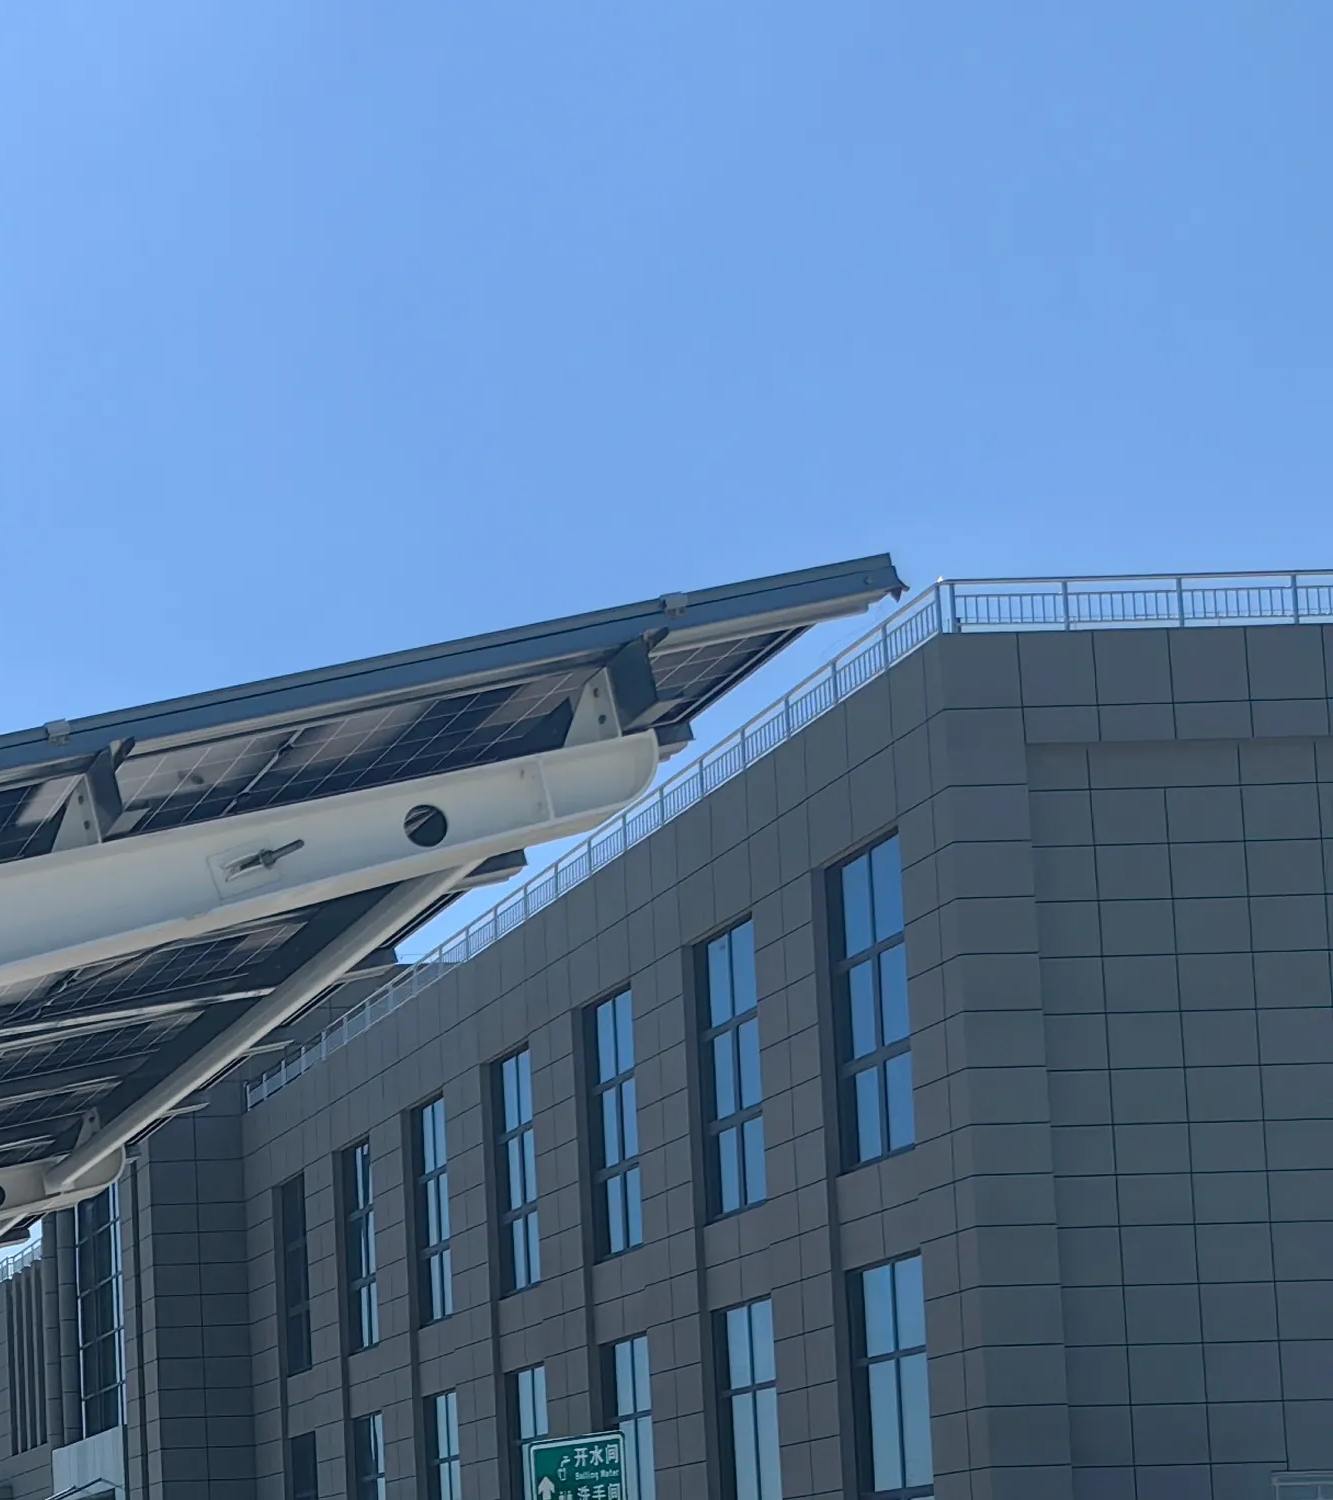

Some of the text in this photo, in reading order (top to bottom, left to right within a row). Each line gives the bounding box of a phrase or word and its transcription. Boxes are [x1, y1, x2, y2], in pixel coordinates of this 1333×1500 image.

[574, 1444, 619, 1468] 开水间
[600, 1469, 619, 1478] Water
